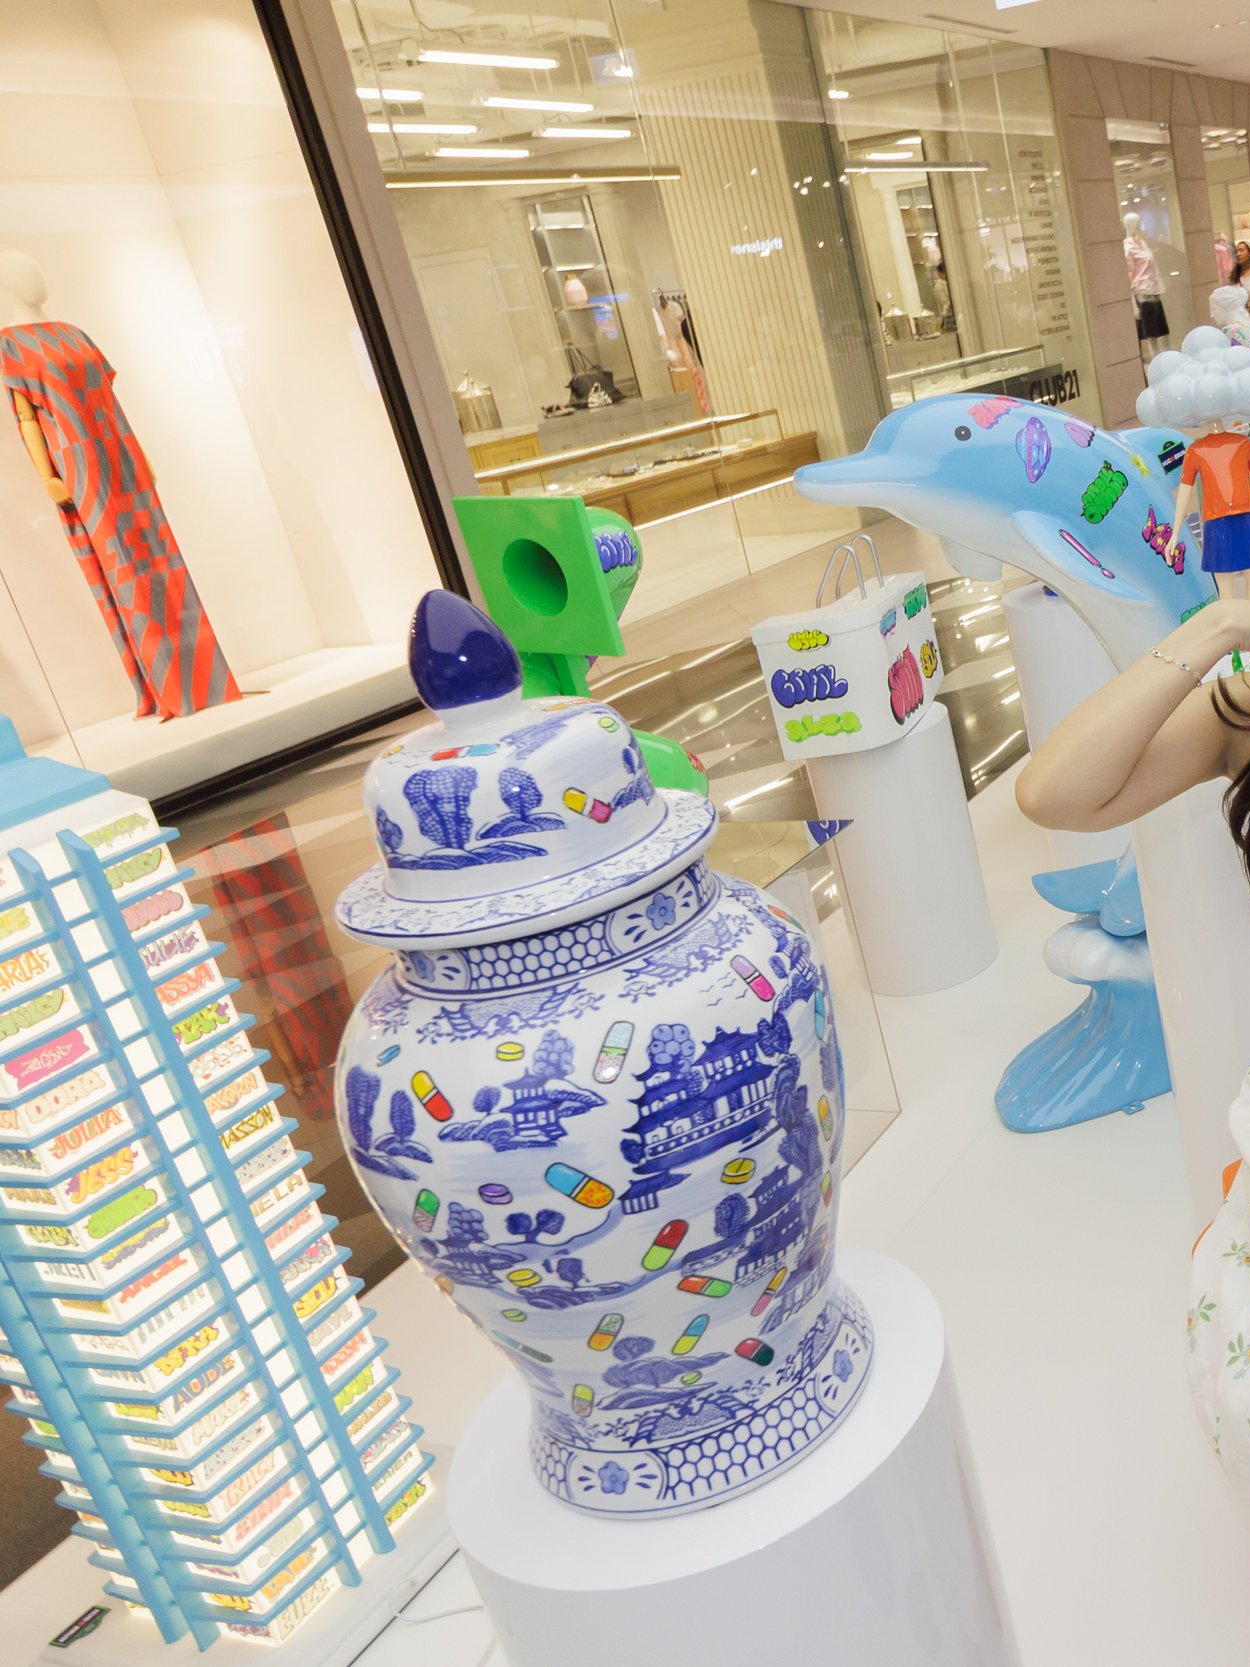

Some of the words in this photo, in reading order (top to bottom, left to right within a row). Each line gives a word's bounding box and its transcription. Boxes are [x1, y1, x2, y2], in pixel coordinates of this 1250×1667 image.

[1029, 368, 1080, 407] CLUB21
[25, 1069, 106, 1125] DORA
[46, 1105, 125, 1161] JULIA
[69, 1147, 138, 1205] JESS
[173, 1354, 237, 1414] AUDE
